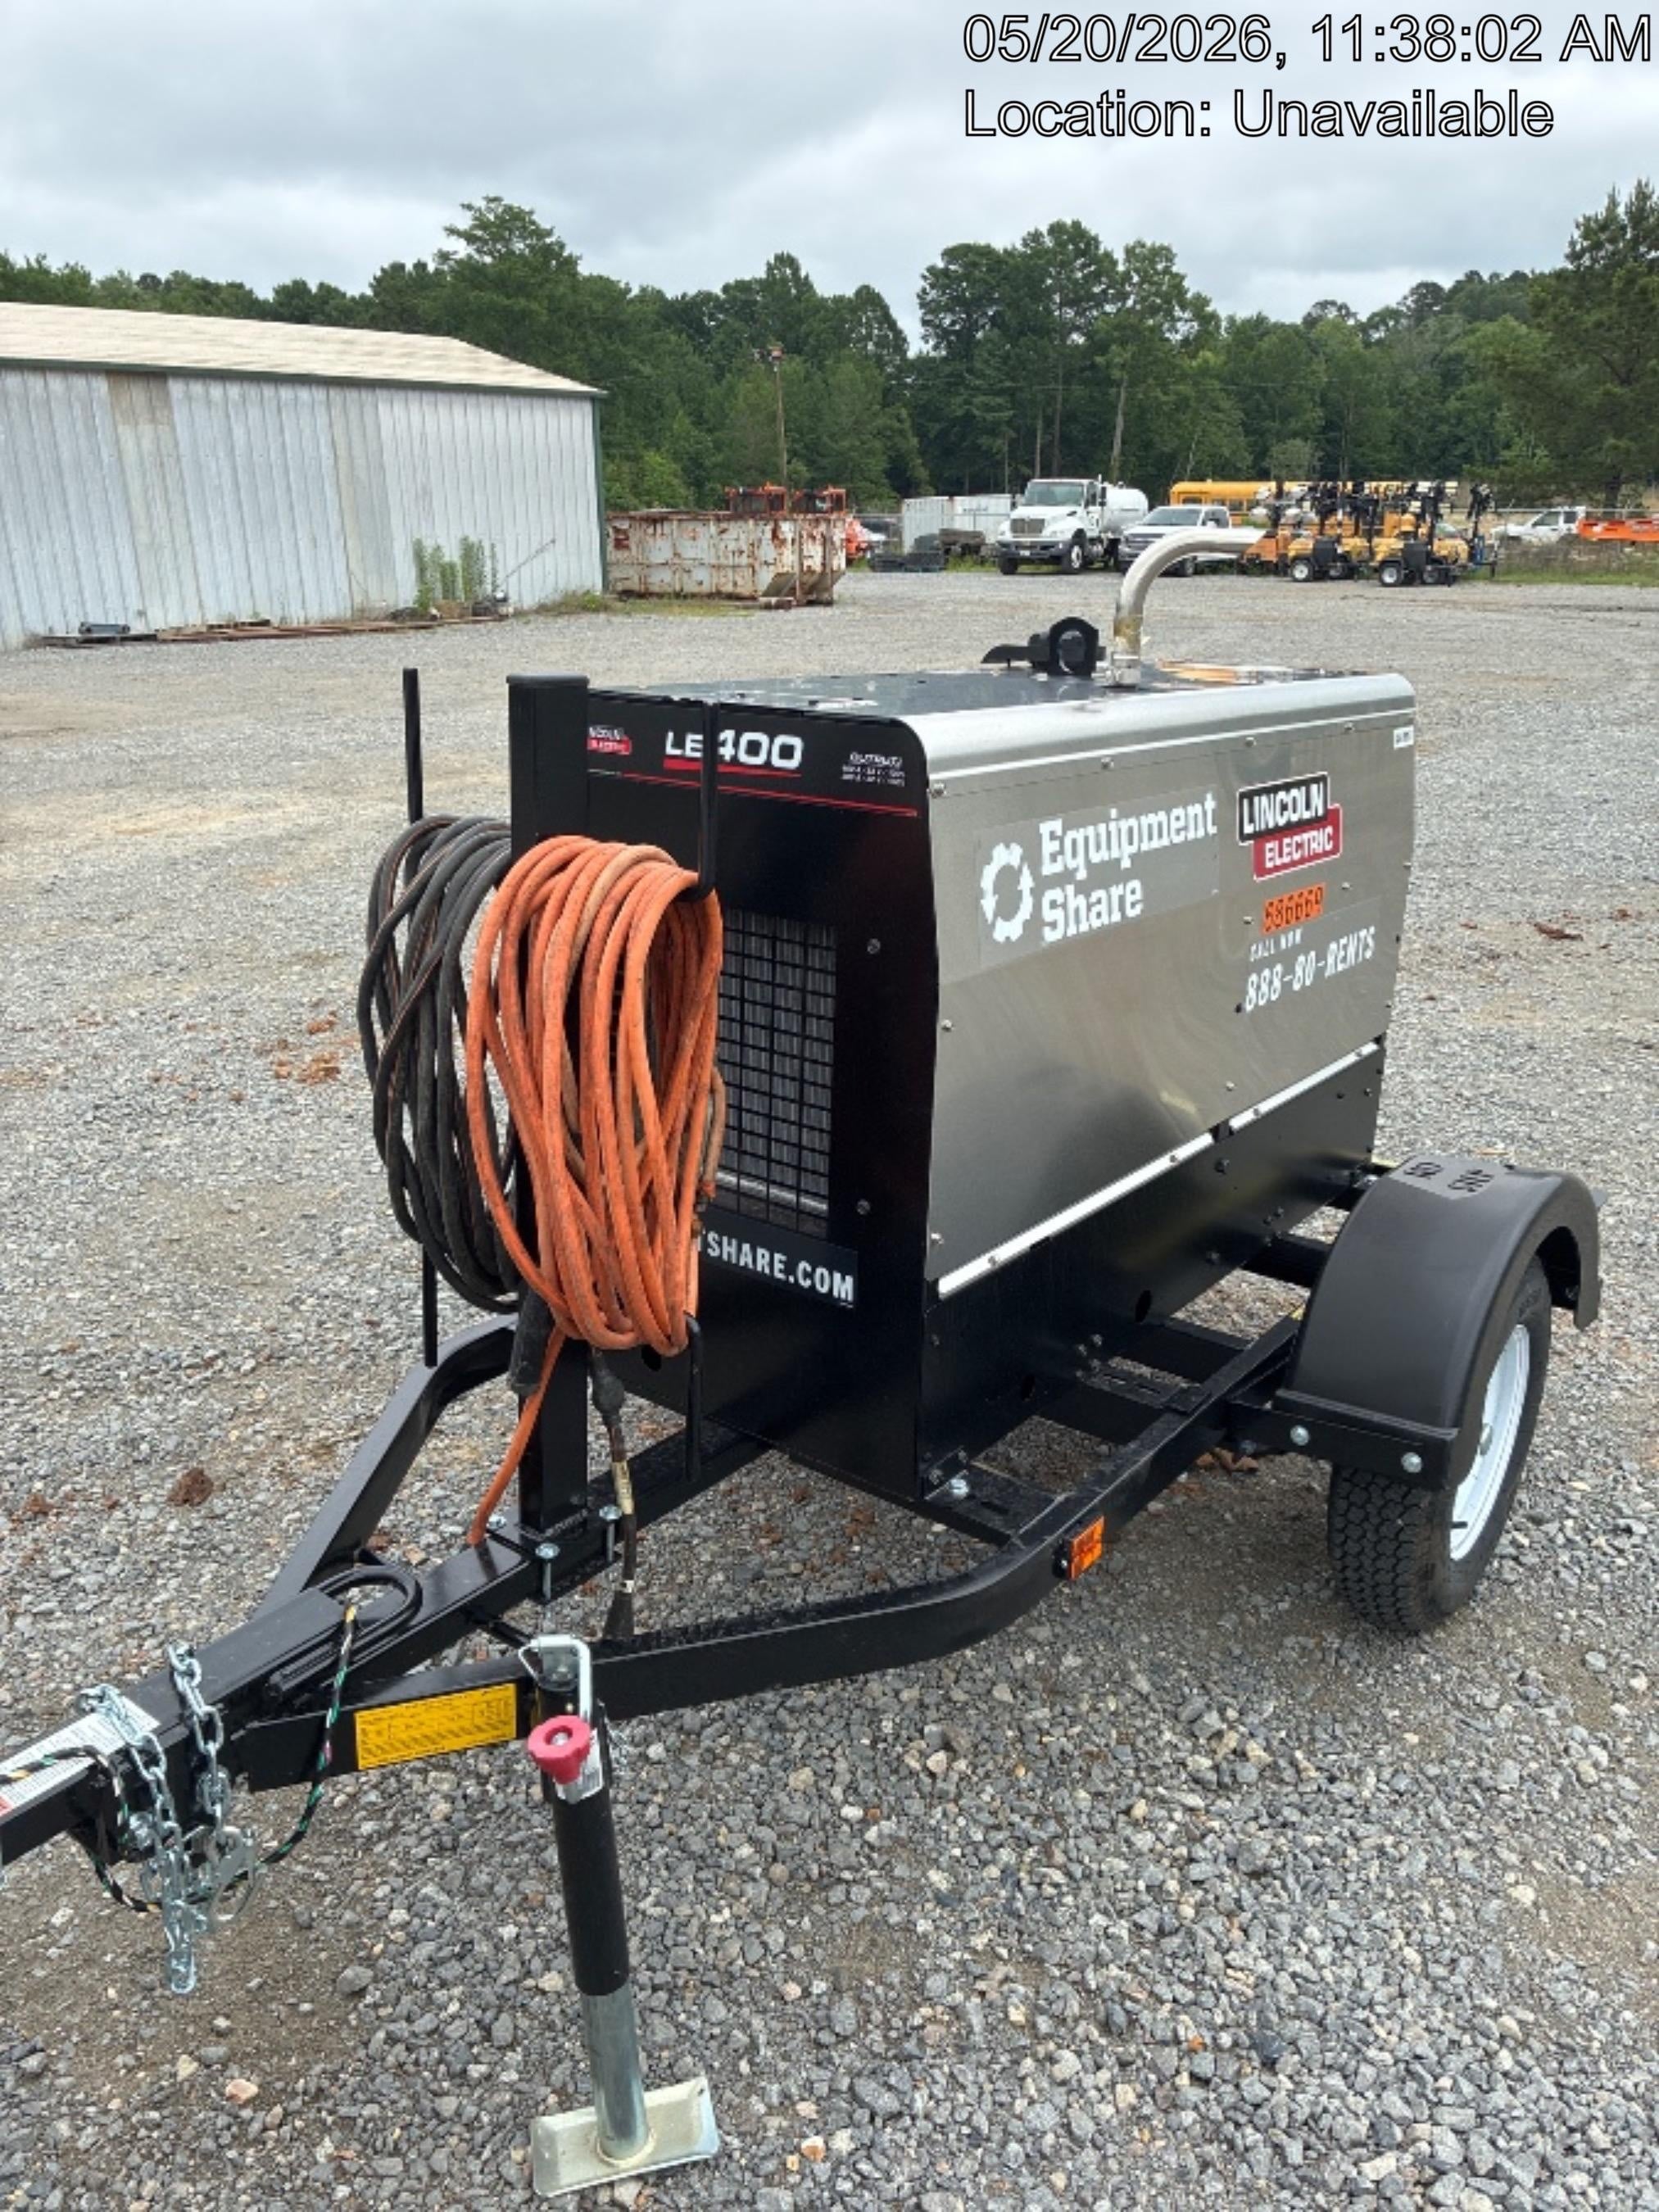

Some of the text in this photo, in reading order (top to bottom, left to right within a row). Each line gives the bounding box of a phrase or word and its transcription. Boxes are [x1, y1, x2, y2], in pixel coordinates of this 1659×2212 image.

[1039, 791, 1218, 881] Equipment
[1242, 782, 1325, 835] LINCOLN
[1264, 824, 1335, 868] ELECTRIC
[1042, 879, 1143, 944] Share
[1245, 926, 1376, 1013] 888-80-RENTS
